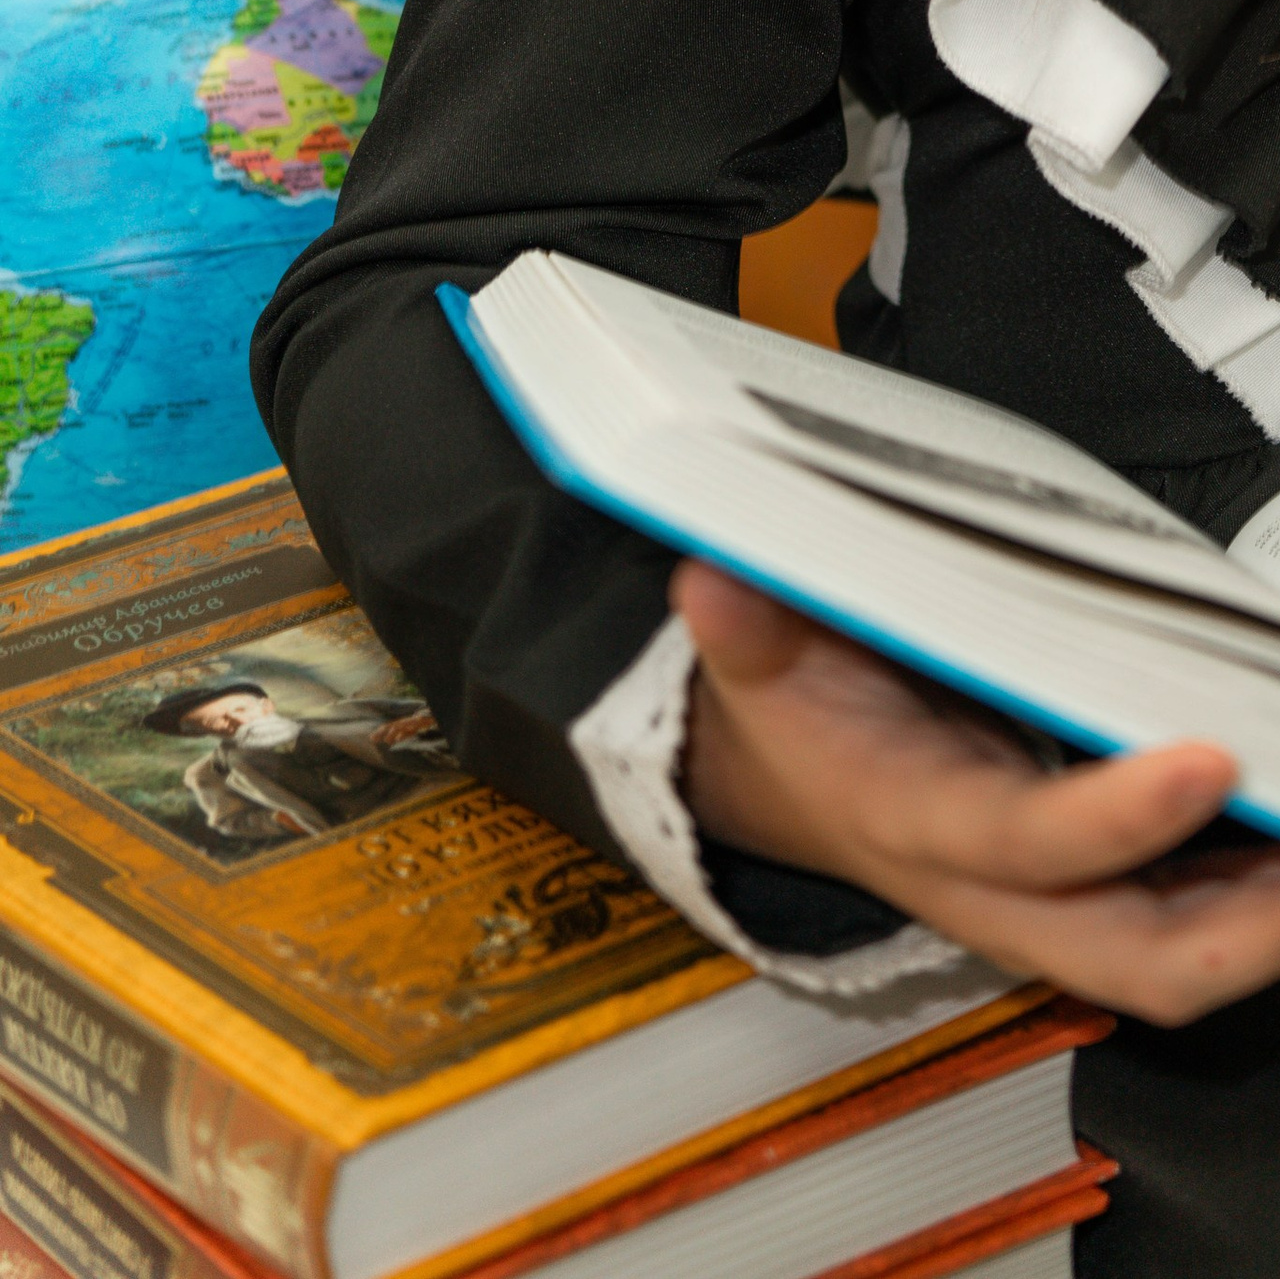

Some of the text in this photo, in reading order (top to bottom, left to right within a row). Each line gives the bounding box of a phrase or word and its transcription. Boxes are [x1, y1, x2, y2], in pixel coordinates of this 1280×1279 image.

[115, 564, 262, 618] Афанасьевич
[73, 596, 224, 652] Обручев
[420, 793, 504, 834] КЯХ
[424, 812, 541, 863] КУЛЬ
